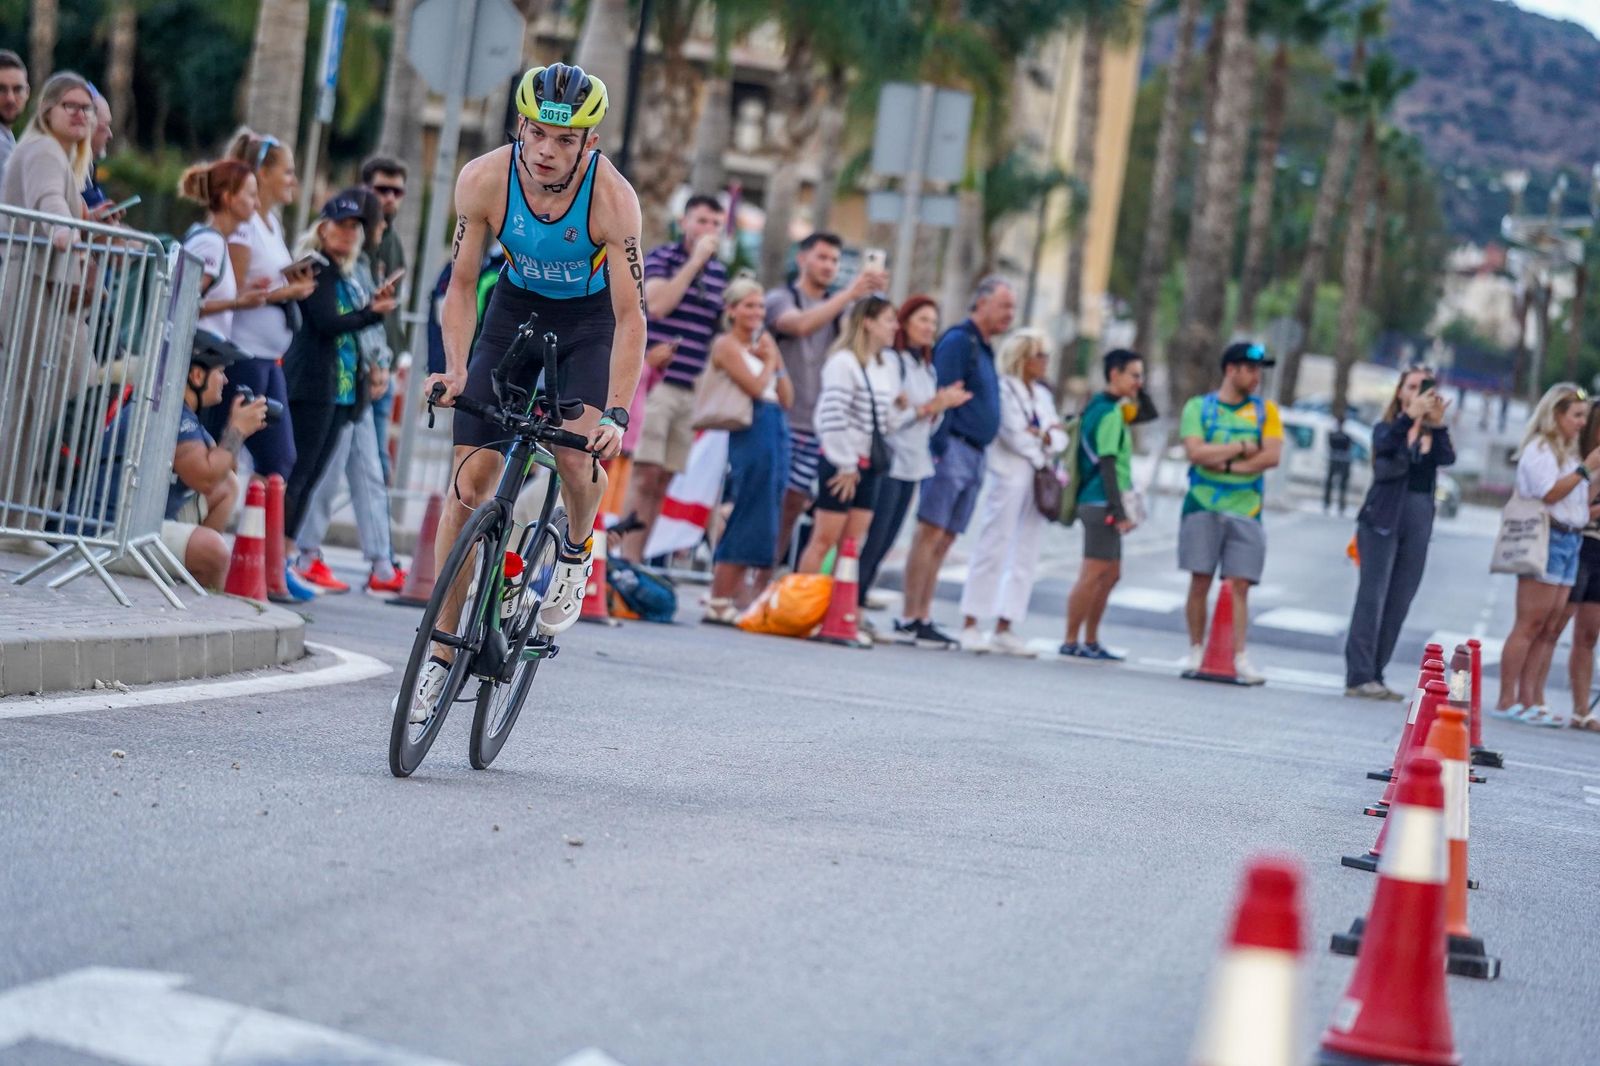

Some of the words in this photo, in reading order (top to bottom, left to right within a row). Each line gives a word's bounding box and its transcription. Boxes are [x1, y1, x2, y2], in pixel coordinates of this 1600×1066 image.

[541, 109, 569, 123] 3019
[513, 251, 538, 268] VAN
[541, 260, 587, 271] DUYSE
[523, 266, 583, 282] BEL
